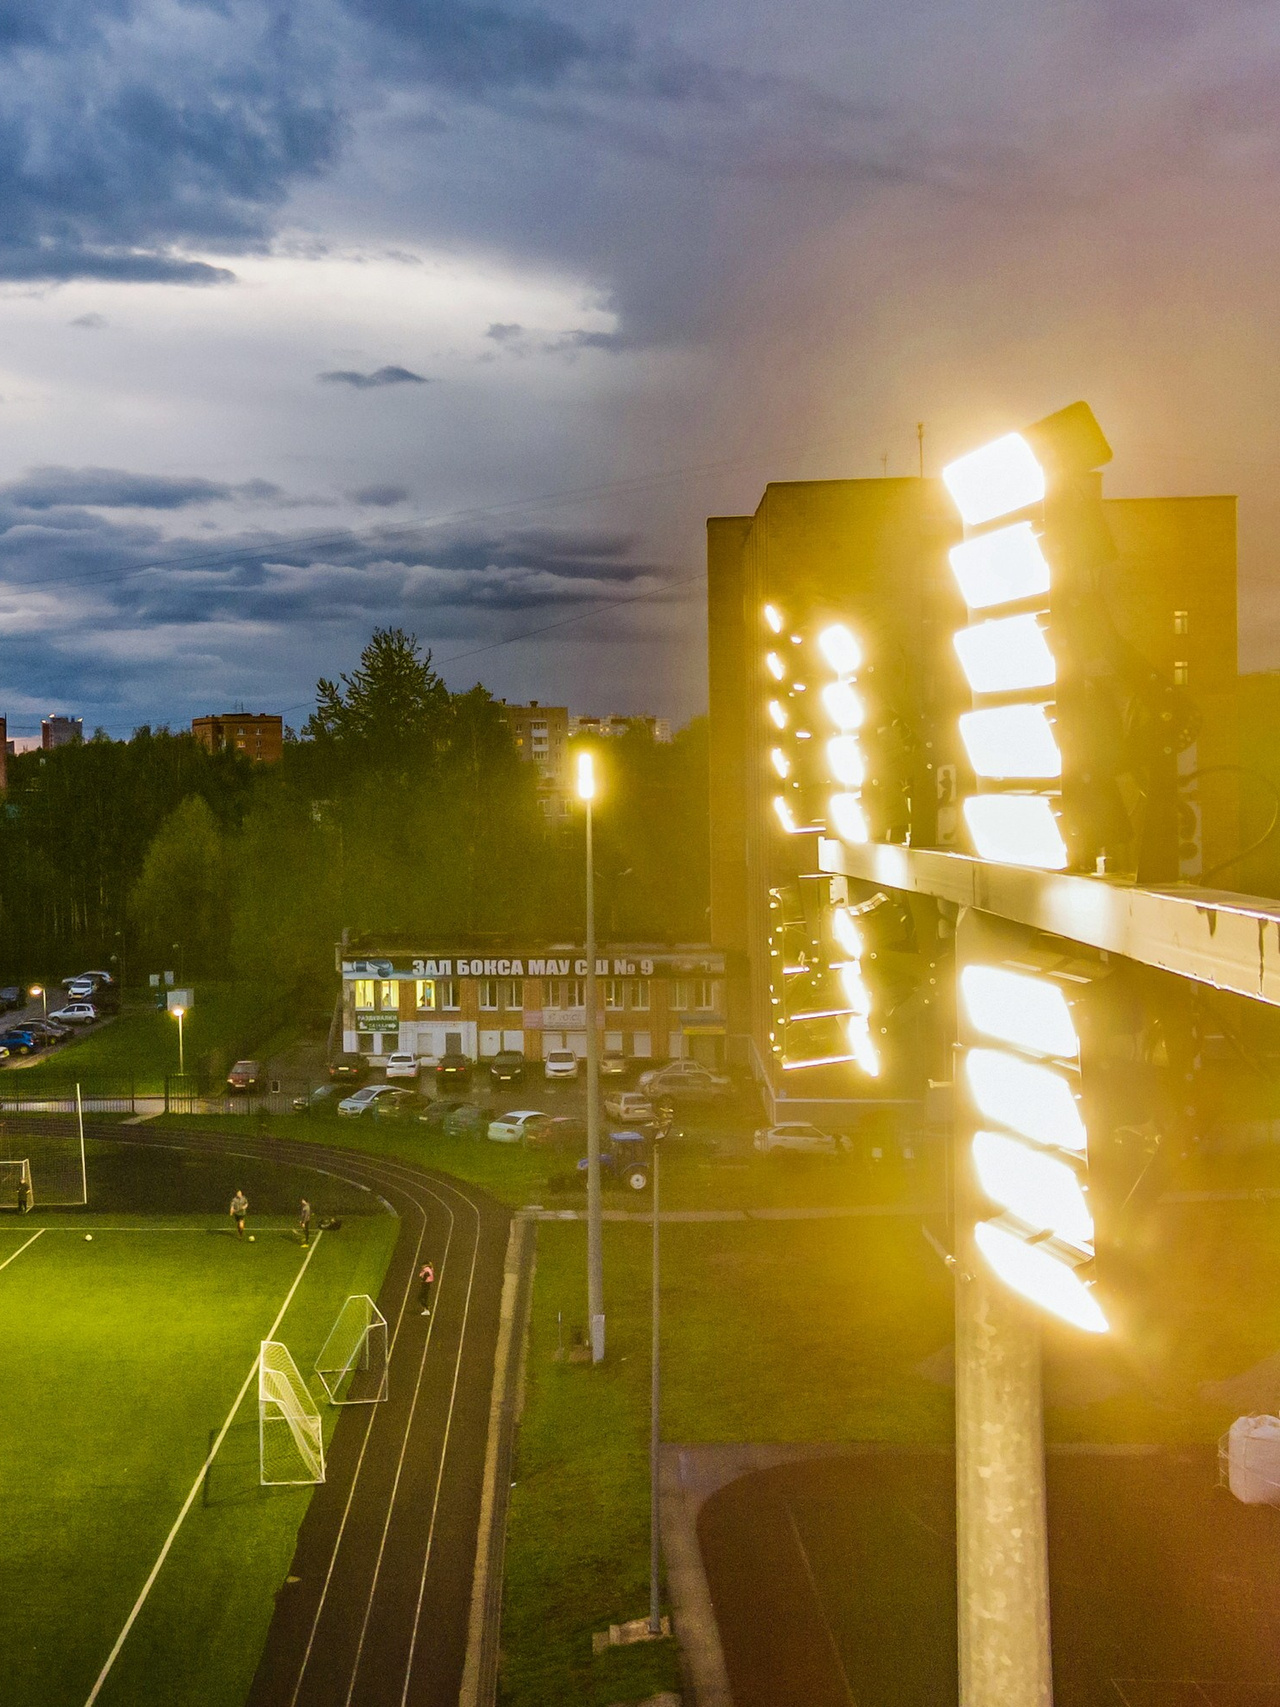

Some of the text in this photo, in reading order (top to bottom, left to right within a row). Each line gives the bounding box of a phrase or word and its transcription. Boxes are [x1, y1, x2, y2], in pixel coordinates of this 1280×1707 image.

[412, 959, 452, 975] ЗАЛ
[456, 959, 524, 975] БОКСА
[528, 959, 571, 975] МАУ
[613, 959, 636, 975] №
[640, 959, 654, 976] 9
